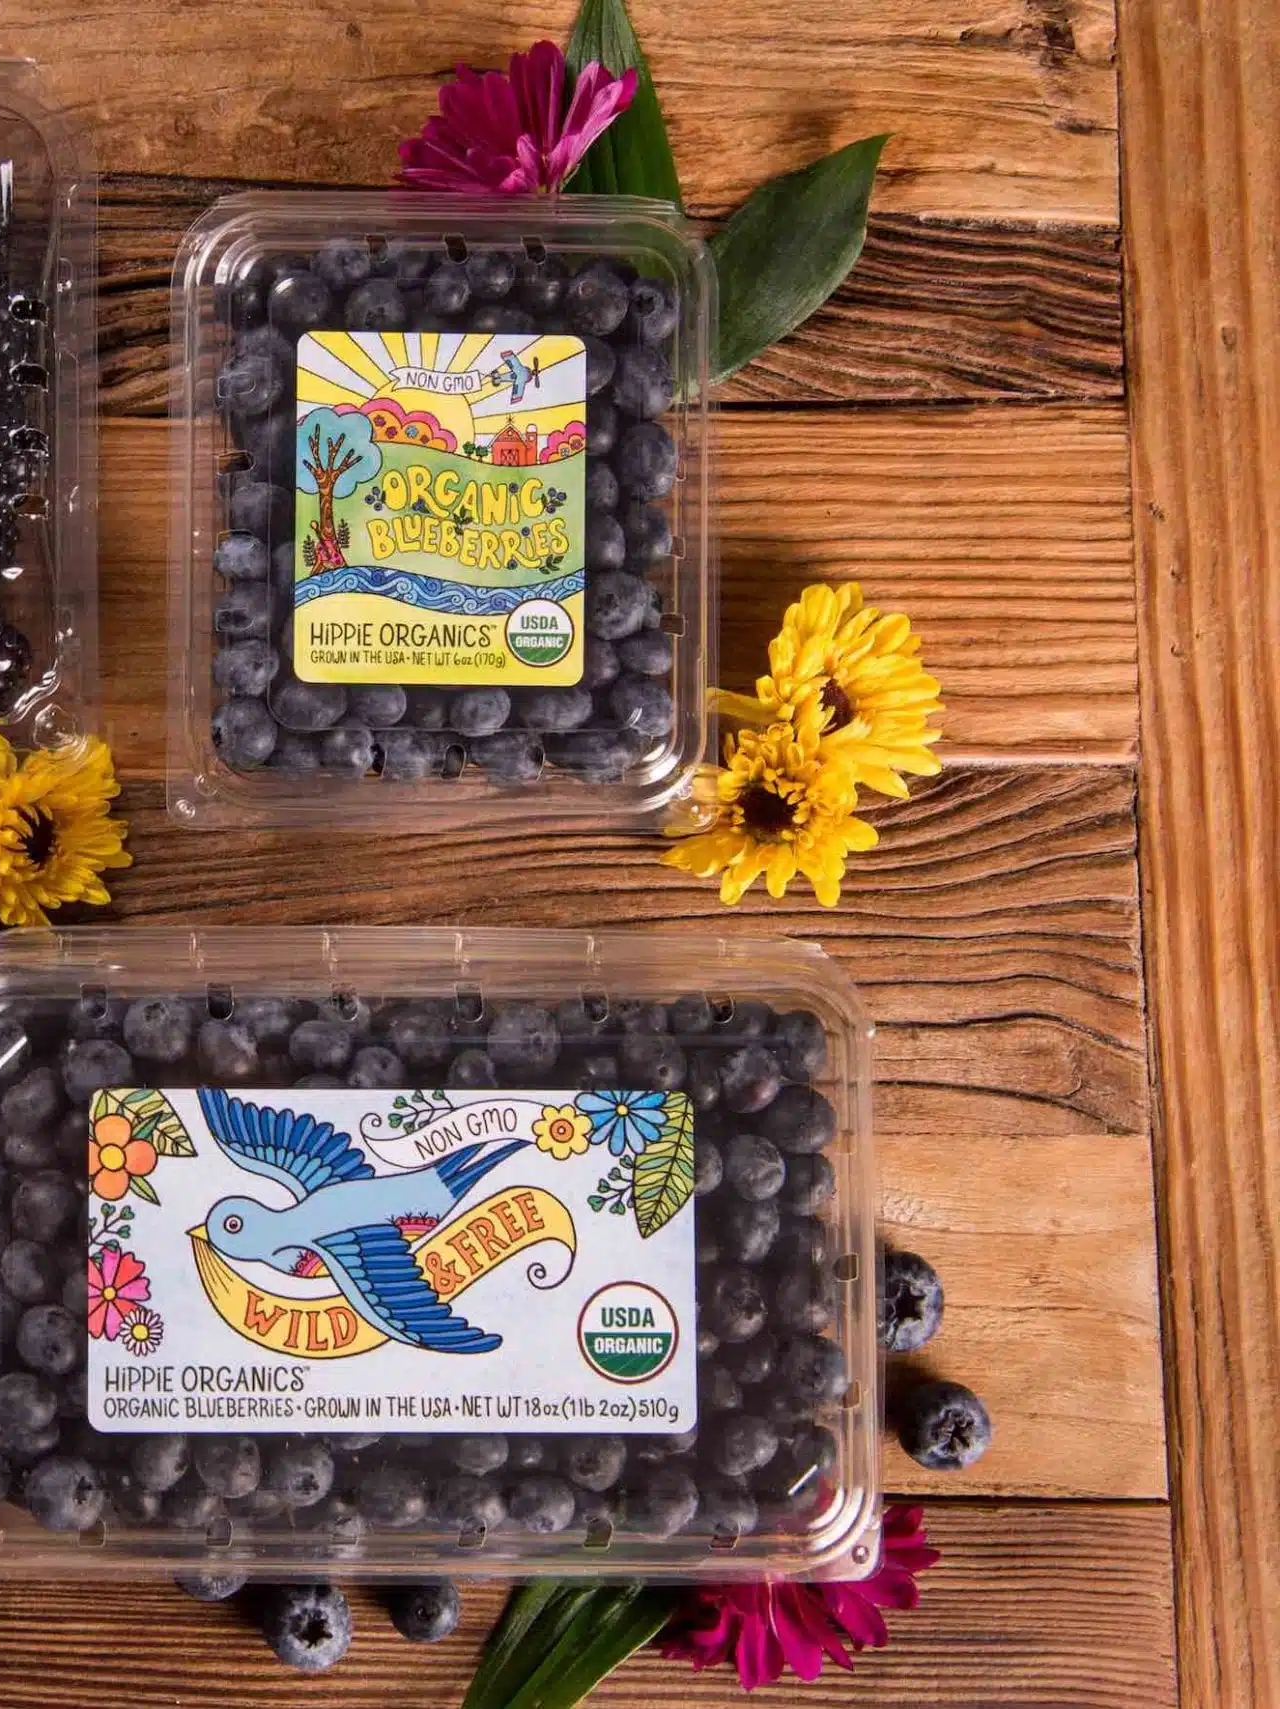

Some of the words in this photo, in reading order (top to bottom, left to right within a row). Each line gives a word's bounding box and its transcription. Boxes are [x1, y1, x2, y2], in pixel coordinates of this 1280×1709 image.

[405, 371, 438, 389] NON
[443, 373, 474, 391] GMO
[520, 616, 559, 631] USDA
[514, 636, 564, 648] ORGANIC
[310, 650, 347, 664] GROWN
[349, 651, 360, 663] IN
[363, 650, 382, 664] THE
[385, 651, 406, 665] USA
[412, 651, 433, 666] NET
[434, 651, 452, 666] WT
[415, 1119, 461, 1160] NON
[467, 1107, 518, 1137] GMO
[445, 1191, 545, 1275] FREE
[243, 1290, 359, 1350] WILD
[601, 1307, 655, 1328] USDA
[593, 1337, 663, 1354] ORGANIC
[304, 1397, 361, 1418] GROWN
[365, 1397, 381, 1417] IN
[388, 1396, 417, 1416] THE
[421, 1396, 452, 1418] USA
[462, 1396, 491, 1418] NET
[496, 1397, 521, 1418] WT
